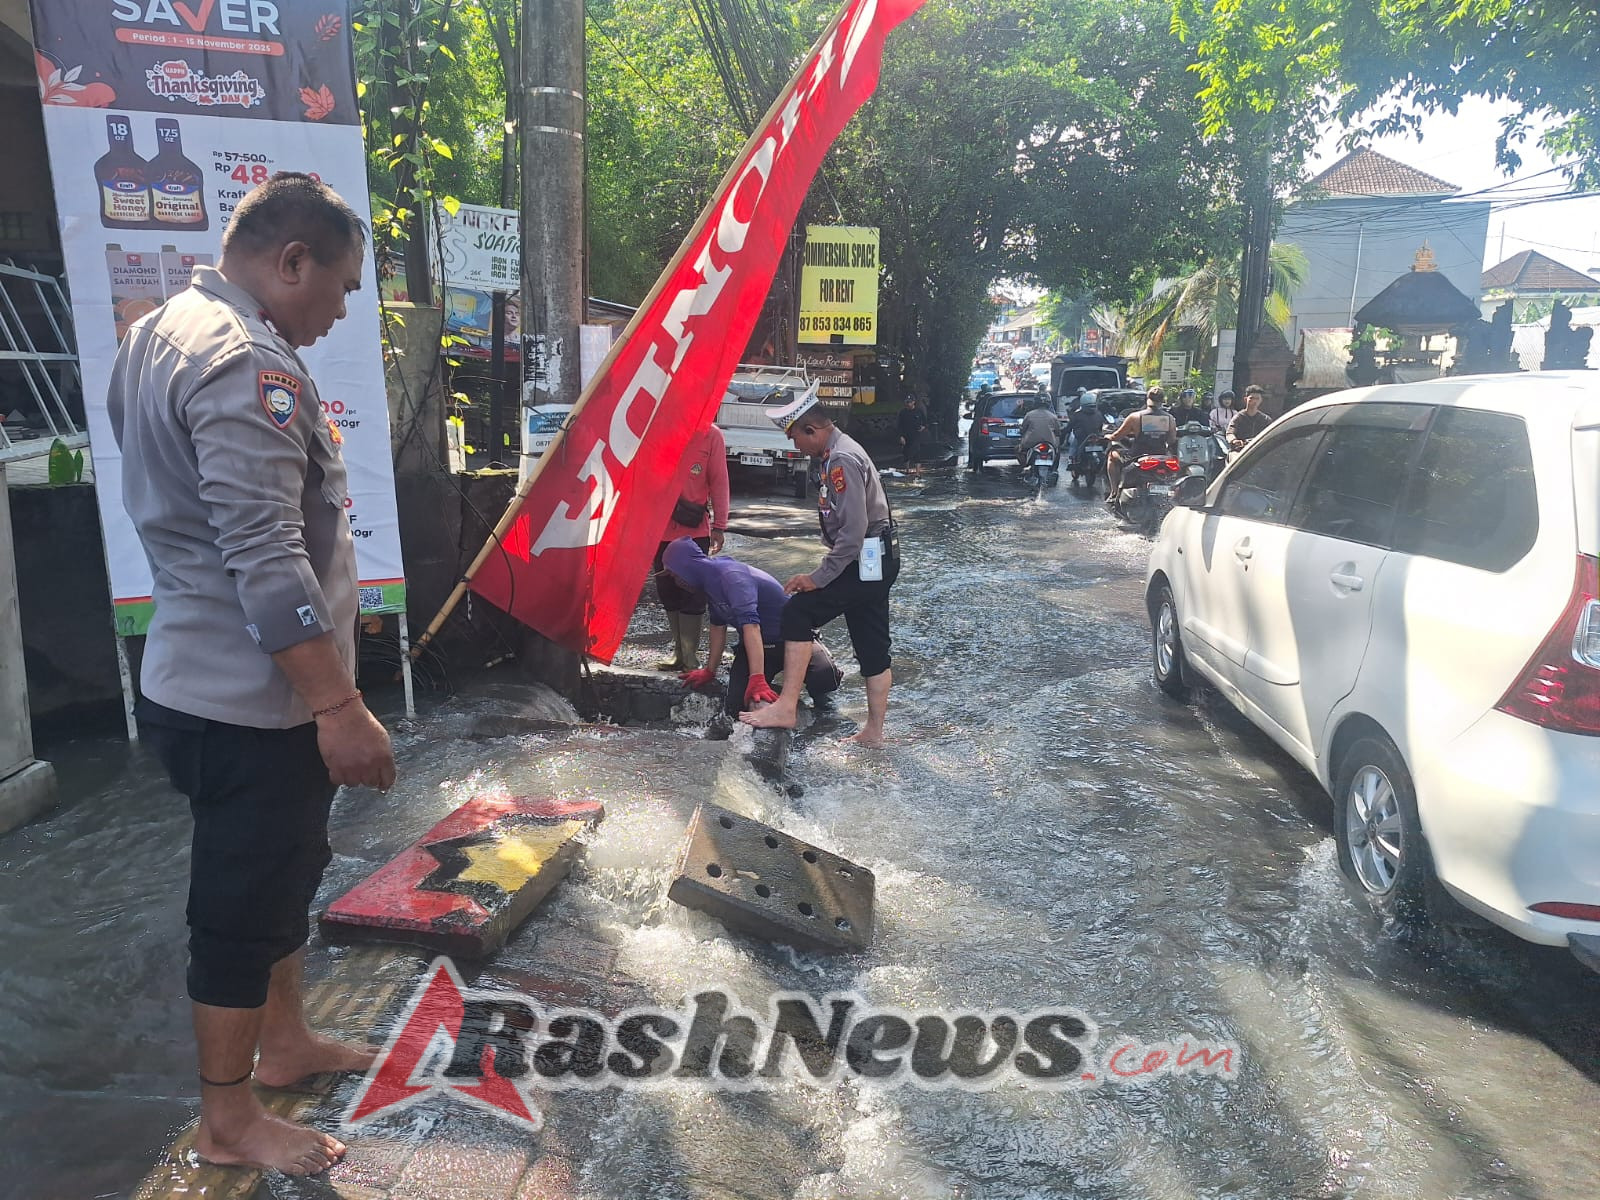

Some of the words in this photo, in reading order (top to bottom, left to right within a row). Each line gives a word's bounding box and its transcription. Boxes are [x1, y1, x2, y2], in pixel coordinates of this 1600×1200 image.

[132, 32, 166, 43] Period
[197, 39, 246, 50] November
[248, 43, 271, 52] 2025
[152, 75, 258, 98] Thanksgiving
[221, 94, 241, 103] DAY
[110, 123, 129, 136] 18
[158, 128, 179, 138] 17.5
[215, 162, 231, 174] Rp
[112, 196, 145, 204] Sweet
[155, 200, 200, 212] Original
[113, 203, 147, 213] Honey
[851, 243, 876, 269] SPACE
[113, 267, 157, 275] DIAMOND
[168, 268, 192, 276] DIAM
[169, 279, 188, 287] SARI
[820, 278, 835, 303] FOR
[835, 279, 855, 303] RENT
[812, 317, 831, 331] 853
[833, 317, 851, 331] 834
[853, 317, 872, 331] 865
